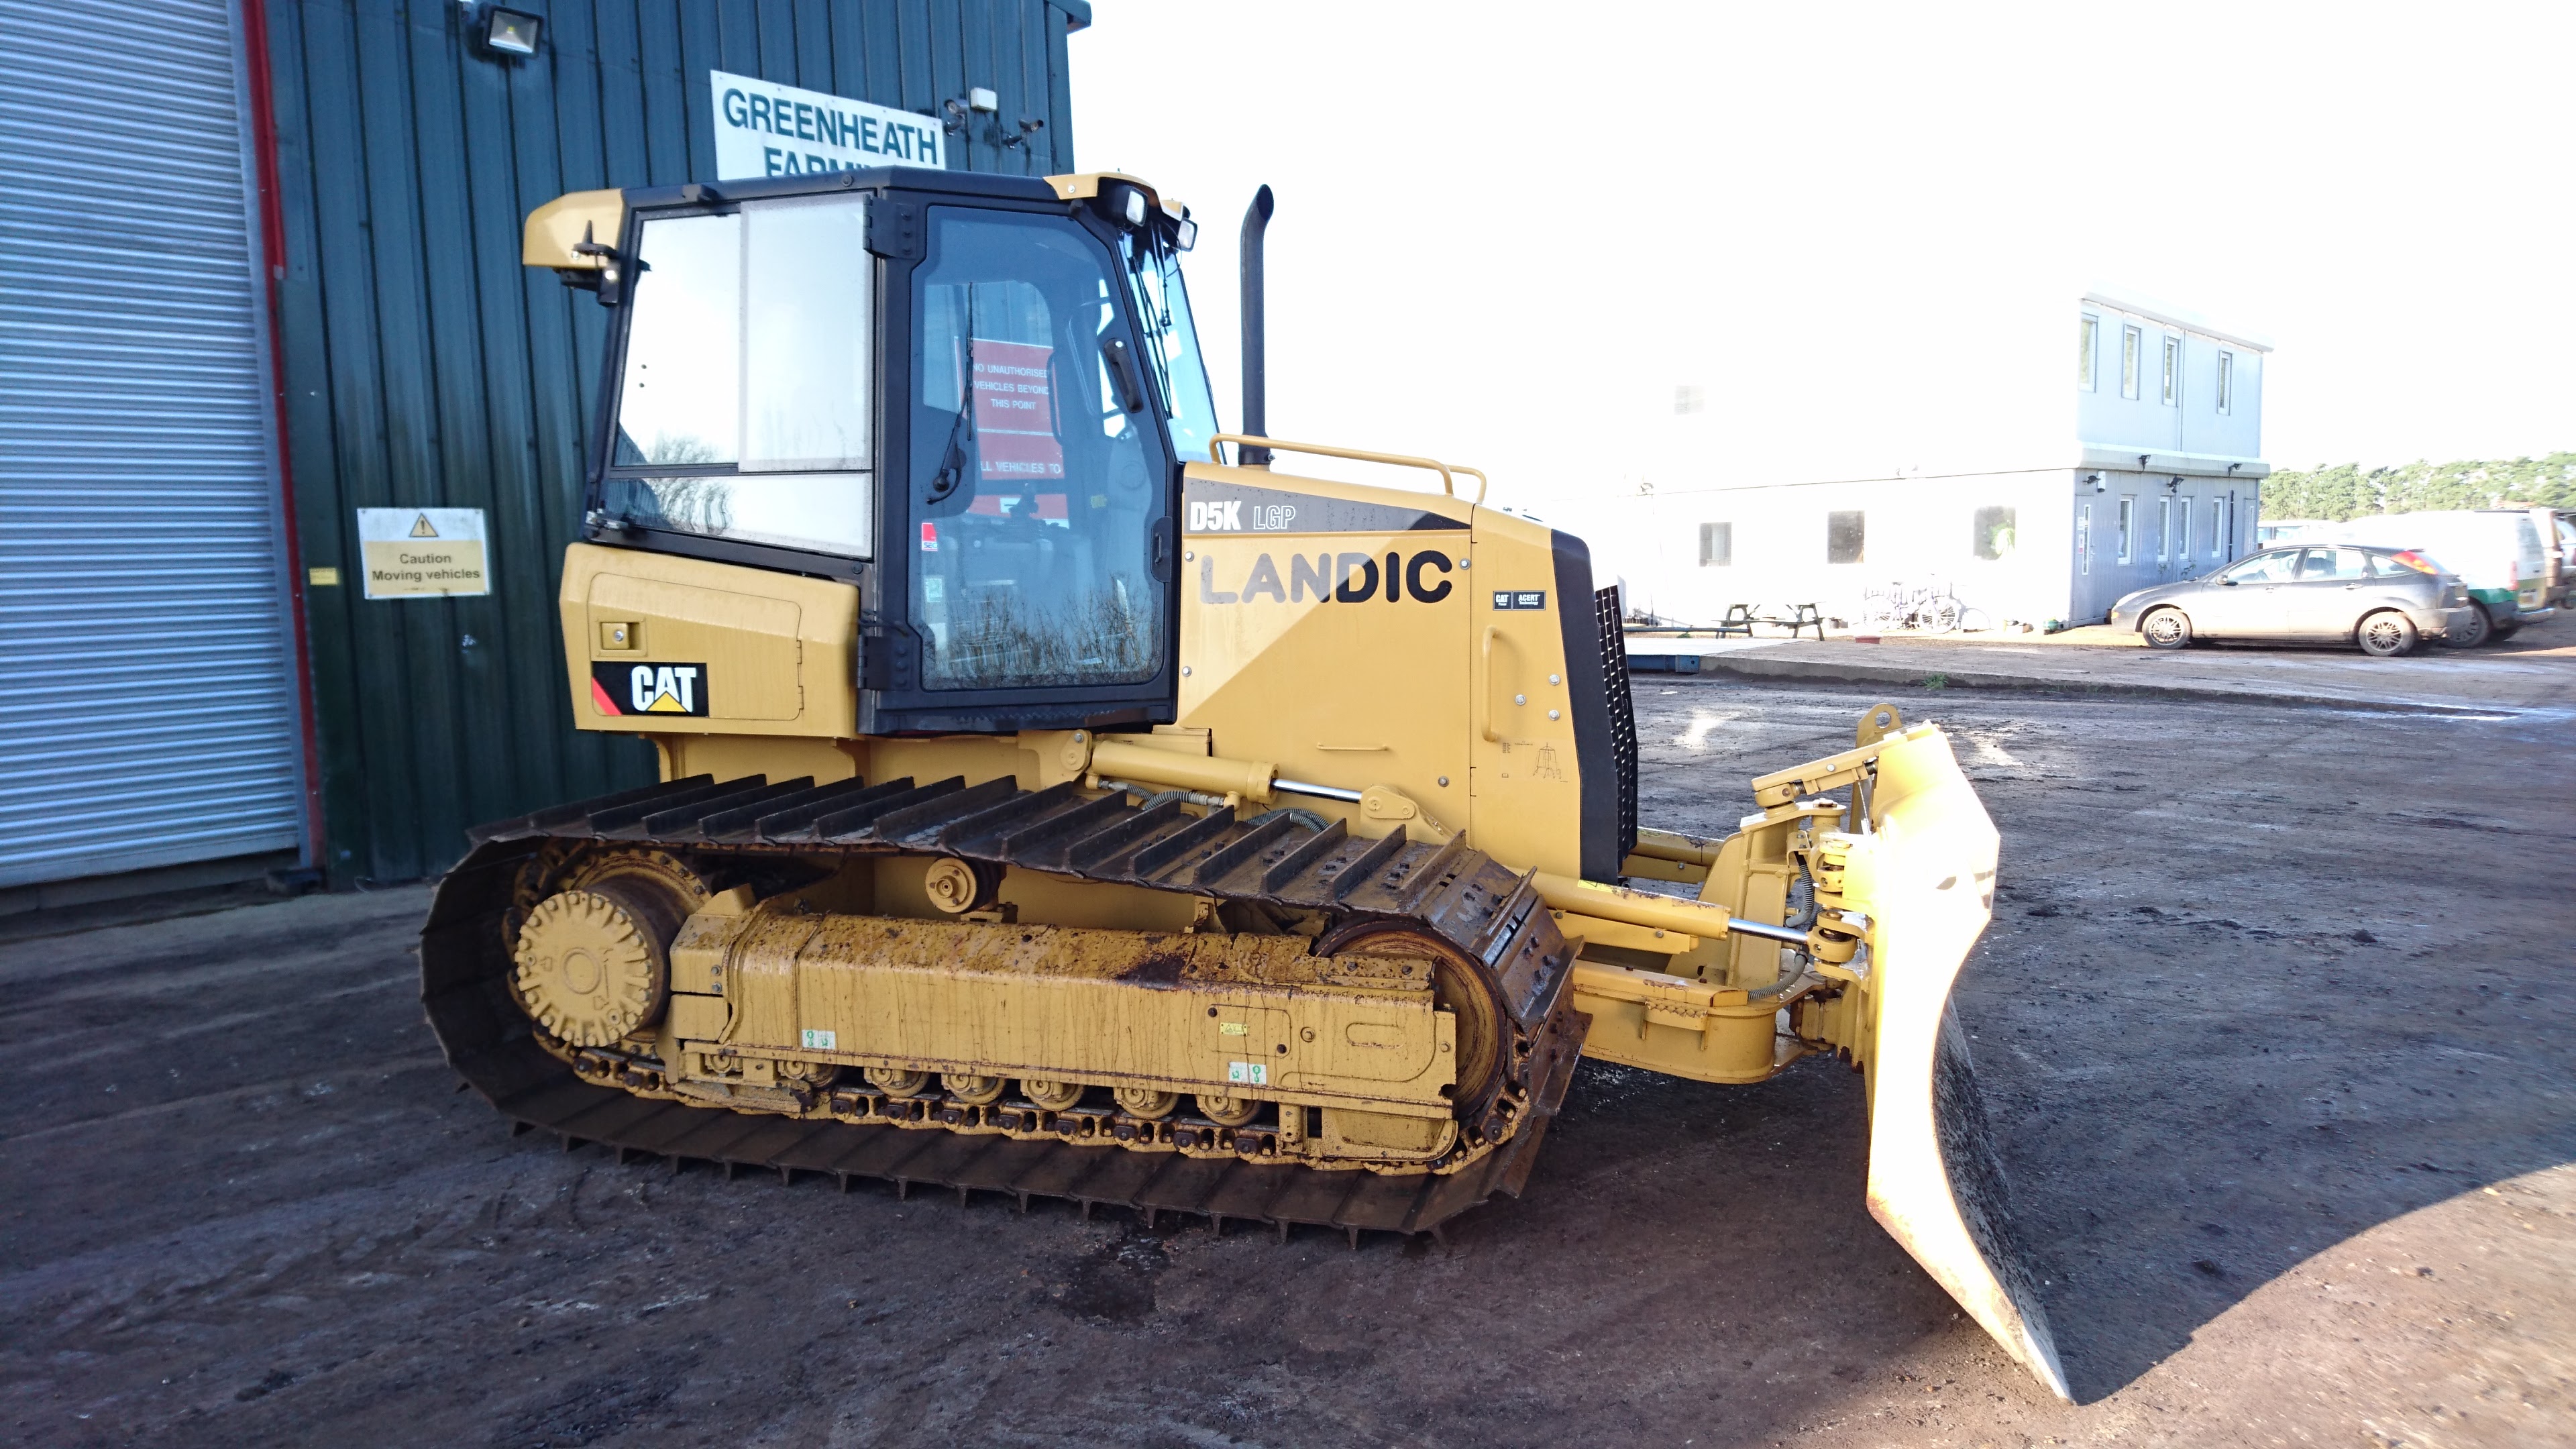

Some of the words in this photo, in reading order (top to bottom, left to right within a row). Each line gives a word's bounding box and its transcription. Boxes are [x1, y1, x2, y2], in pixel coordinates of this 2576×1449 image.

[722, 88, 938, 165] GREENHEATH
[974, 380, 1014, 392] VEHICLES
[990, 398, 1010, 409] THIS
[1012, 400, 1036, 410] POINT
[979, 461, 992, 472] LL
[996, 462, 1044, 474] VEHICLES
[1189, 500, 1242, 531] D5K
[1253, 505, 1296, 530] LGP
[399, 553, 451, 564] Caution
[372, 570, 422, 582] Moving
[426, 569, 480, 579] vehicles
[1200, 550, 1452, 604] LANDIC
[1495, 594, 1509, 603] CAT
[631, 665, 696, 712] CAT
